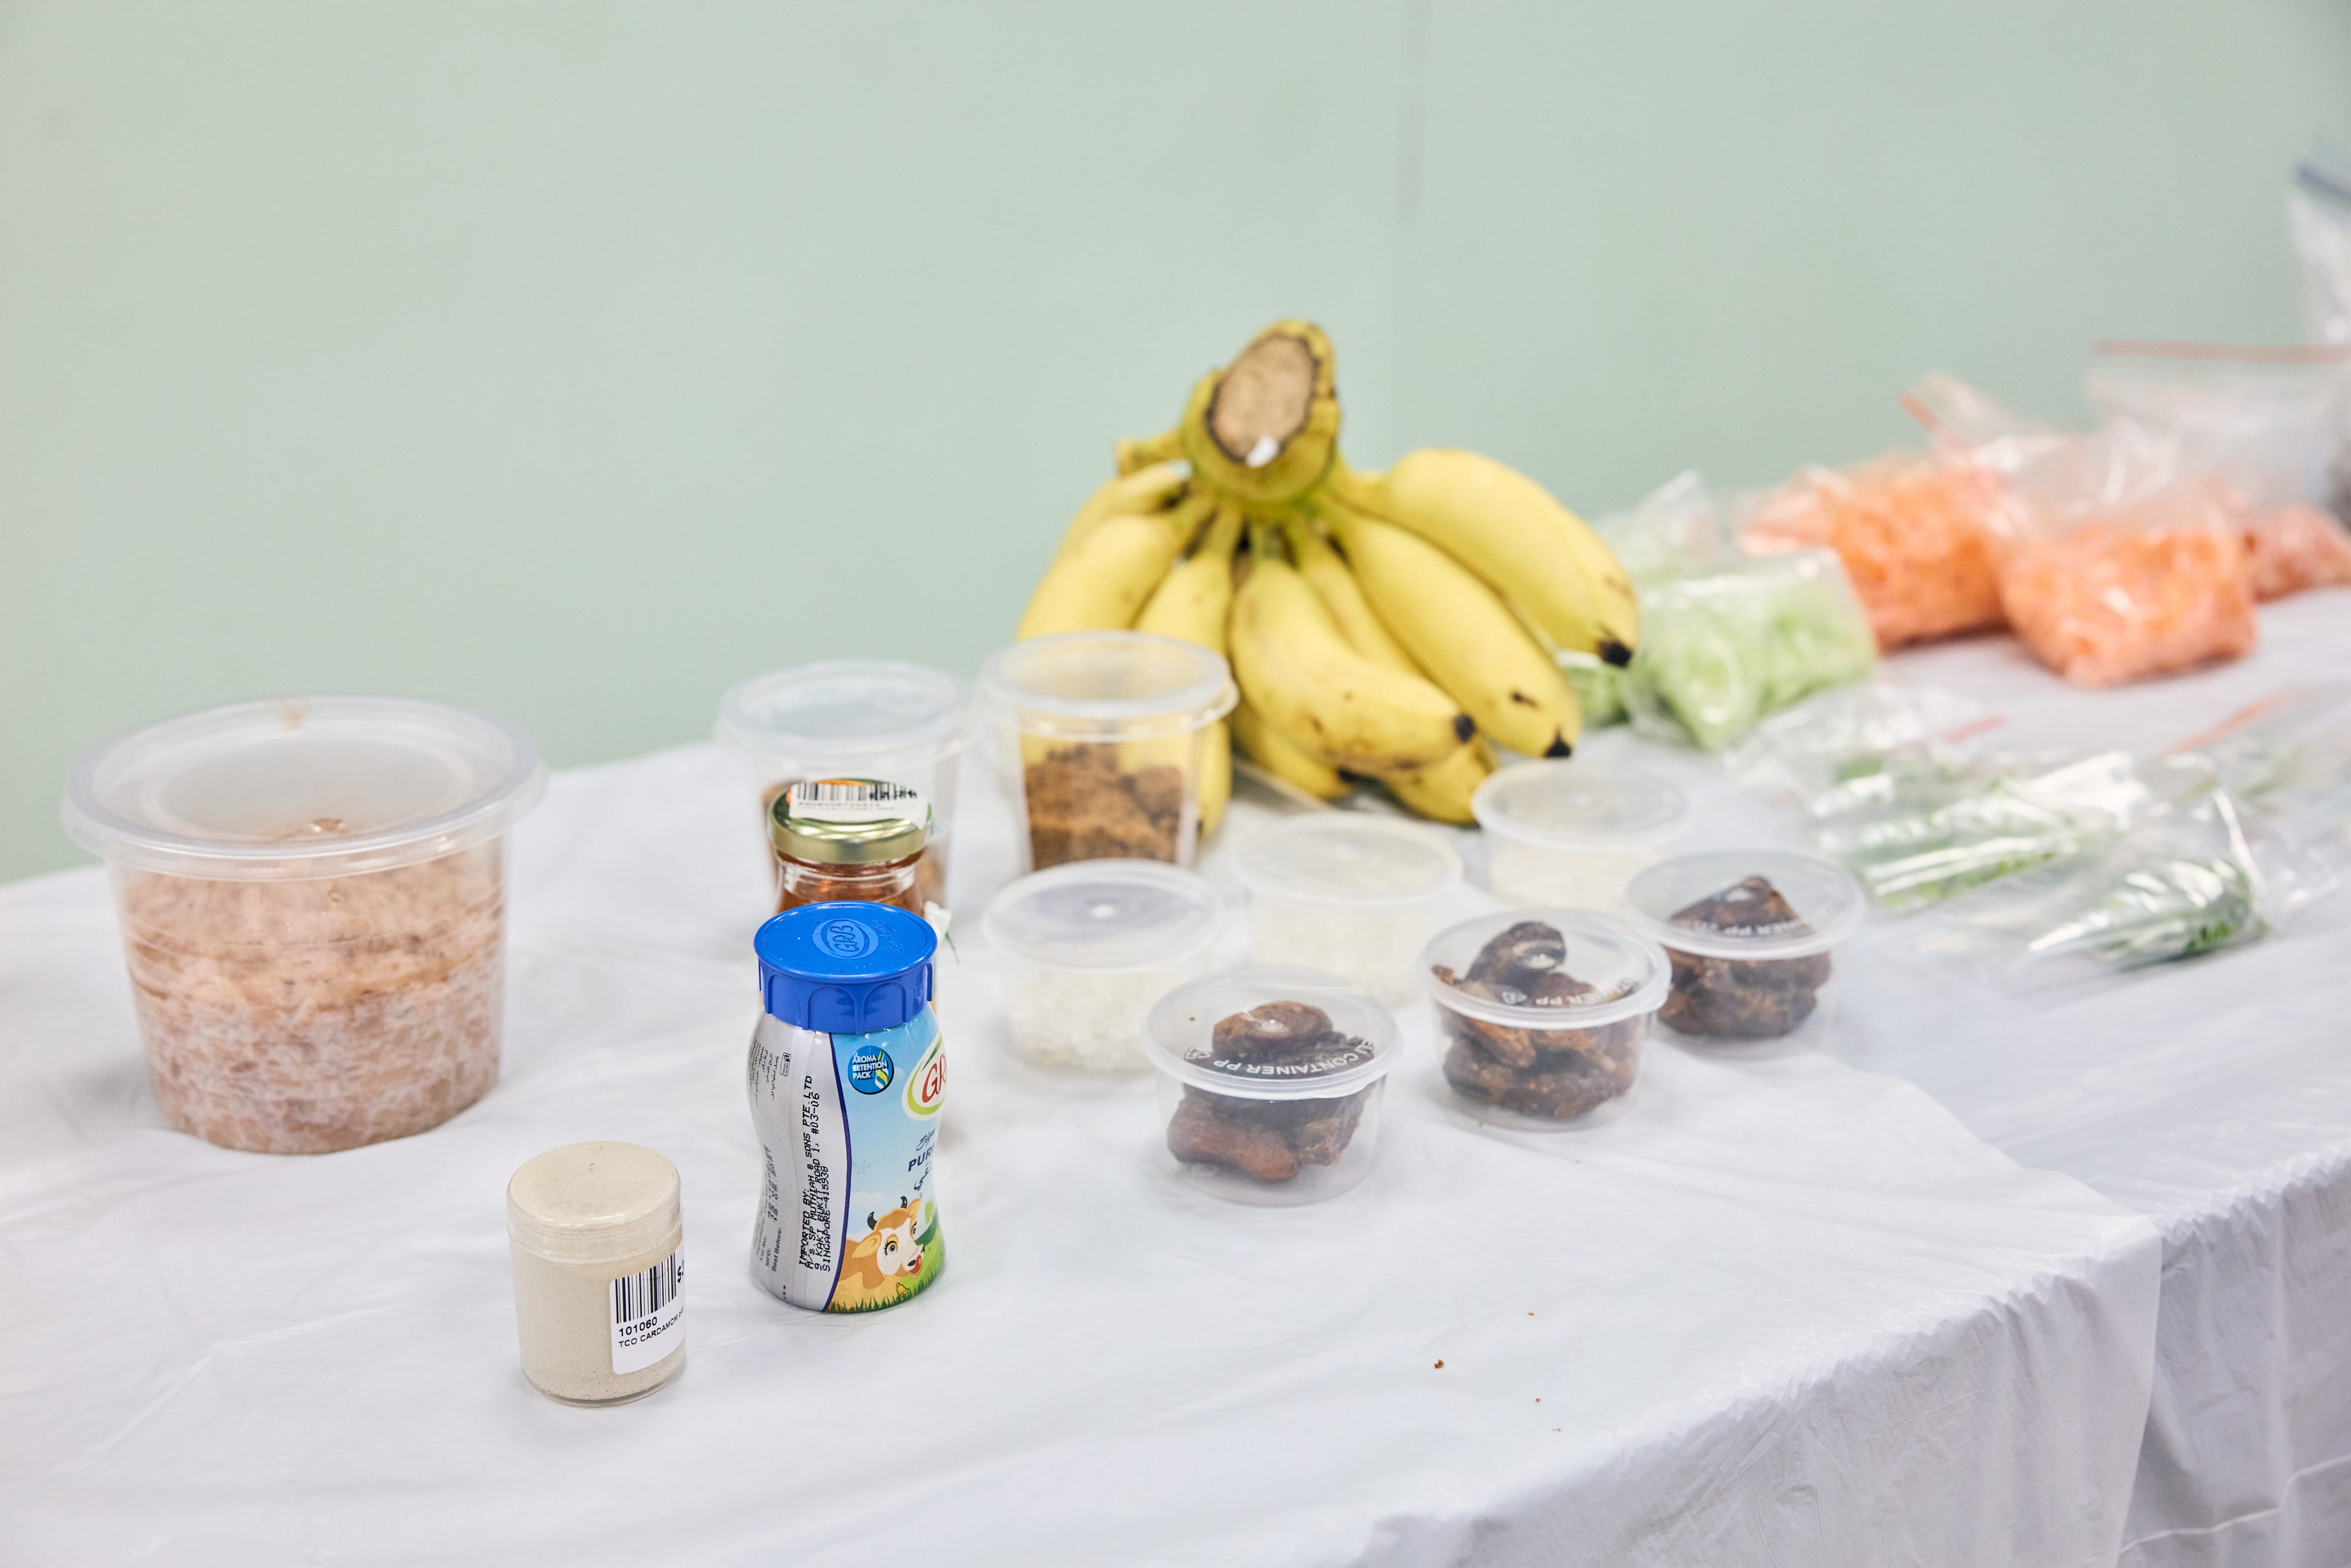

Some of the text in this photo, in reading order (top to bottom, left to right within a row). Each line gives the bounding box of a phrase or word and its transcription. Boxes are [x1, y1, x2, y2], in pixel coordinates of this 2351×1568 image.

[829, 924, 860, 952] GRB
[852, 1054, 878, 1064] AROMA
[1213, 1059, 1242, 1071] PP
[1245, 1052, 1359, 1076] CONTAINER
[852, 1071, 872, 1080] PACK
[810, 1091, 820, 1134] #03-06
[803, 1132, 812, 1158] SONS
[813, 1158, 822, 1184] ROAD
[808, 1174, 817, 1221] MUTHIAH
[815, 1188, 824, 1222] BUKIT
[799, 1188, 812, 1265] IMPORTED BY:
[773, 1227, 782, 1254] Before:
[815, 1228, 824, 1257] KAKI
[813, 1263, 822, 1271] 9
[618, 1314, 679, 1348] TCO CARDAMOM
[619, 1316, 658, 1337] 101060
